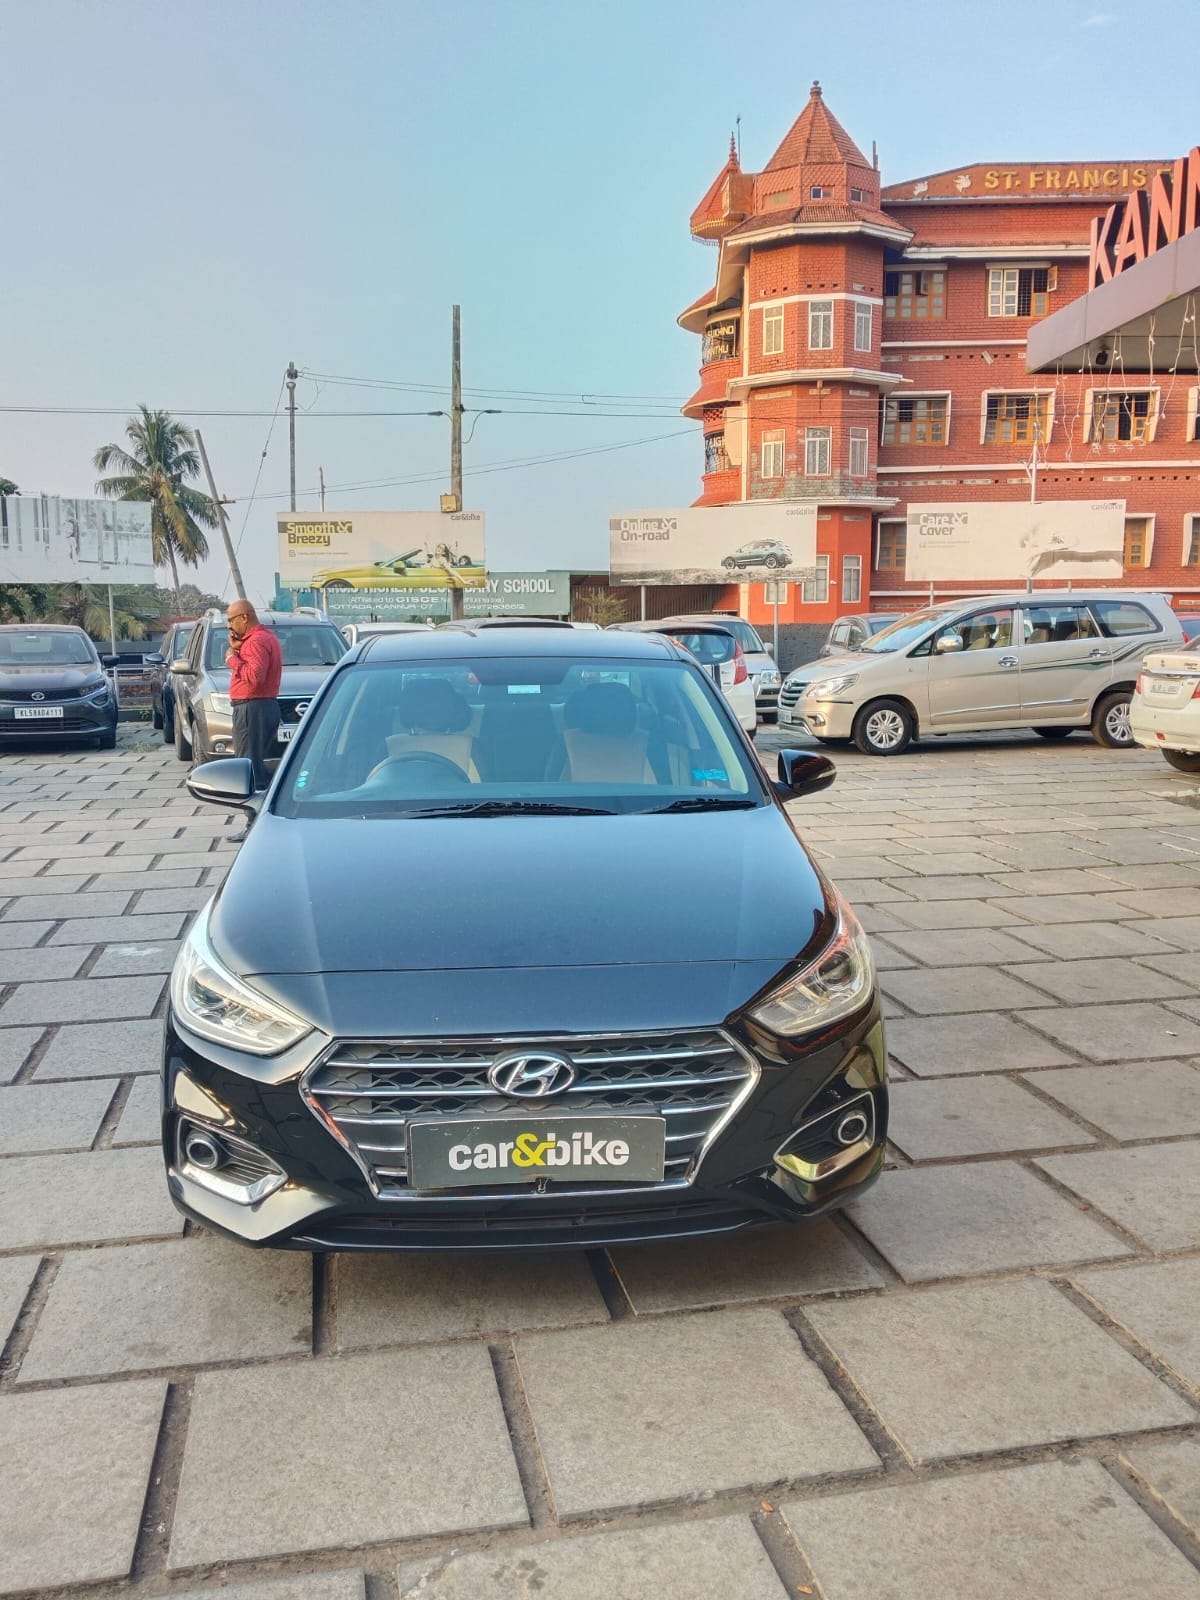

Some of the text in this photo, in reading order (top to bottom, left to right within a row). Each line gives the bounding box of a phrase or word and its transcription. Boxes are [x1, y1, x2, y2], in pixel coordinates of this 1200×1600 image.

[984, 170, 1021, 189] ST.
[1029, 168, 1148, 190] FRANCIS
[620, 519, 659, 531] Online
[920, 513, 950, 526] Care
[287, 521, 335, 535] Smooth
[920, 525, 955, 536] Cover
[287, 533, 331, 546] Breezy
[621, 530, 670, 541] On-road
[503, 578, 554, 594] SCHOOL
[448, 1131, 630, 1171] car&bike
